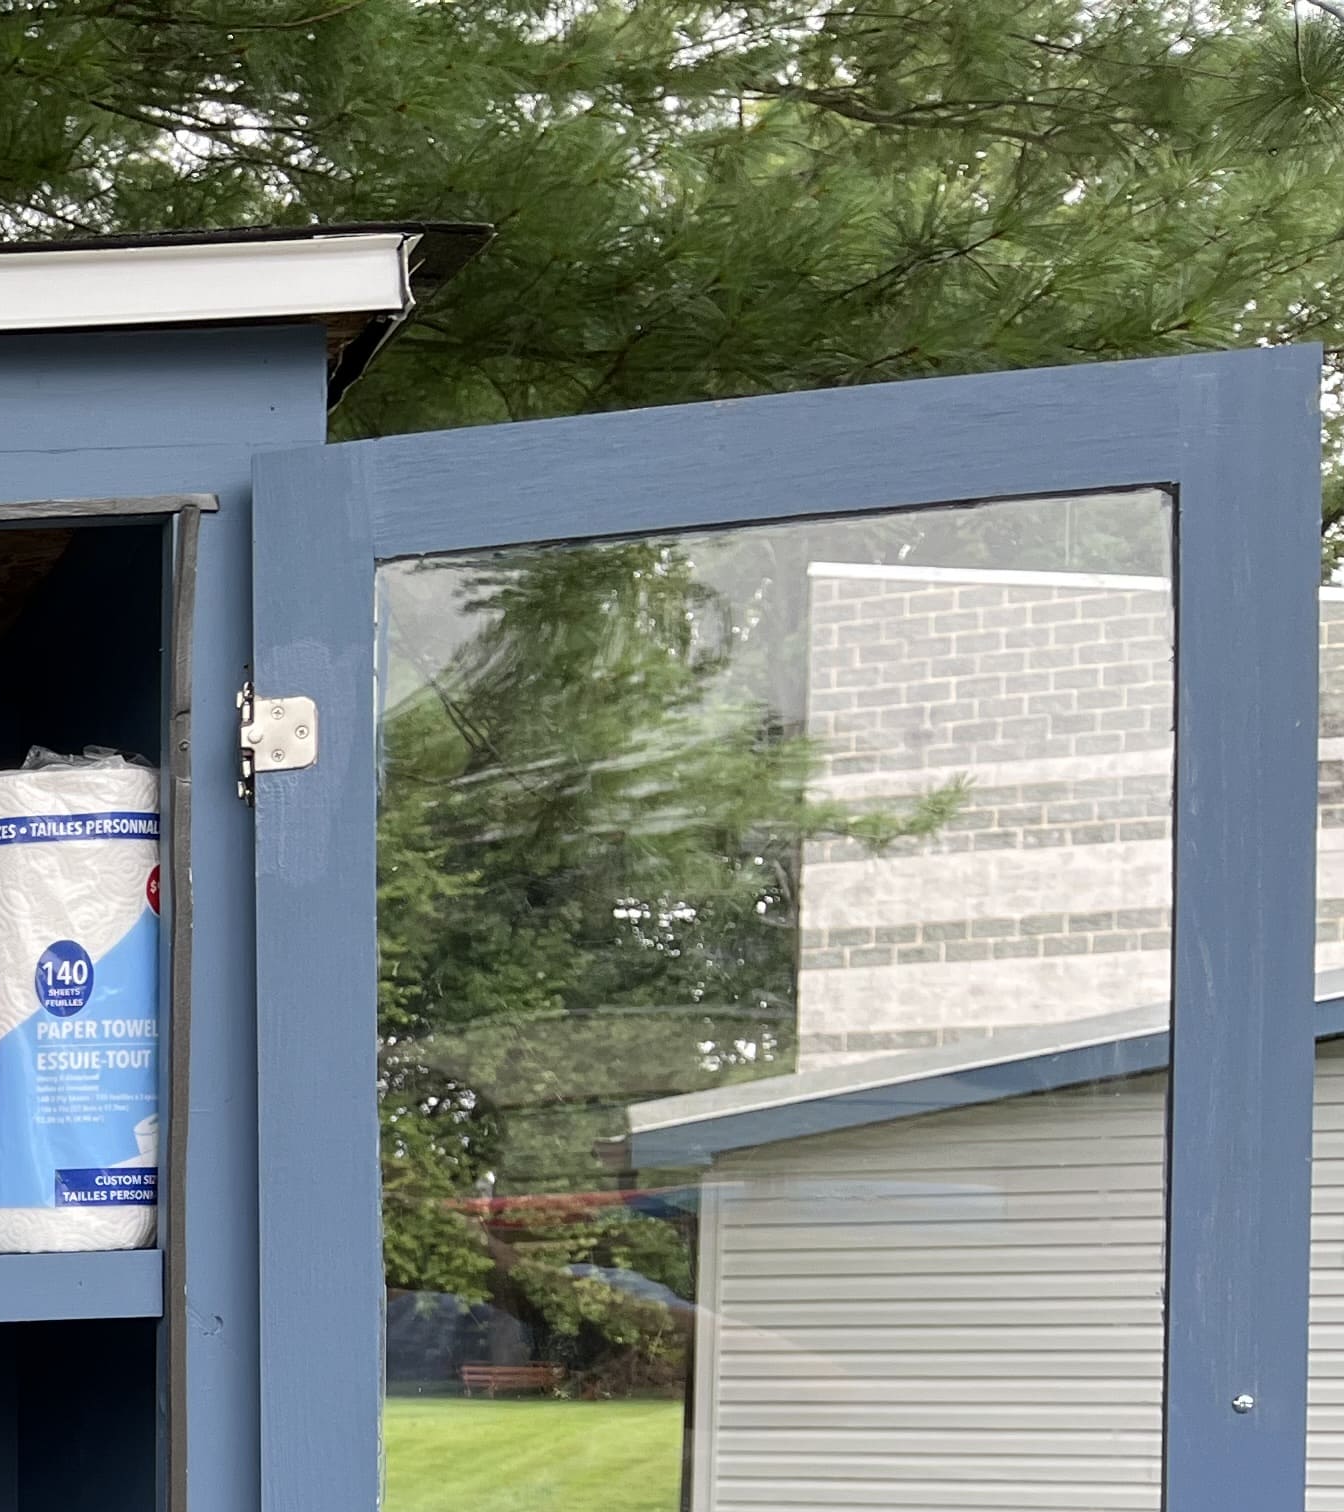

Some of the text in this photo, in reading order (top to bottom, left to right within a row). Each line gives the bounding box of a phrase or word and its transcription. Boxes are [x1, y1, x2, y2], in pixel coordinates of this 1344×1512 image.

[29, 821, 83, 837] TAILLES
[41, 960, 89, 986] 140
[47, 988, 81, 997] SHEETS
[45, 999, 84, 1007] FEUILLES
[36, 1020, 98, 1041] PAPER
[36, 1049, 152, 1072] ESSUIE-TOUT
[94, 1175, 142, 1186] CUSTOM
[62, 1190, 108, 1202] TAILLES
